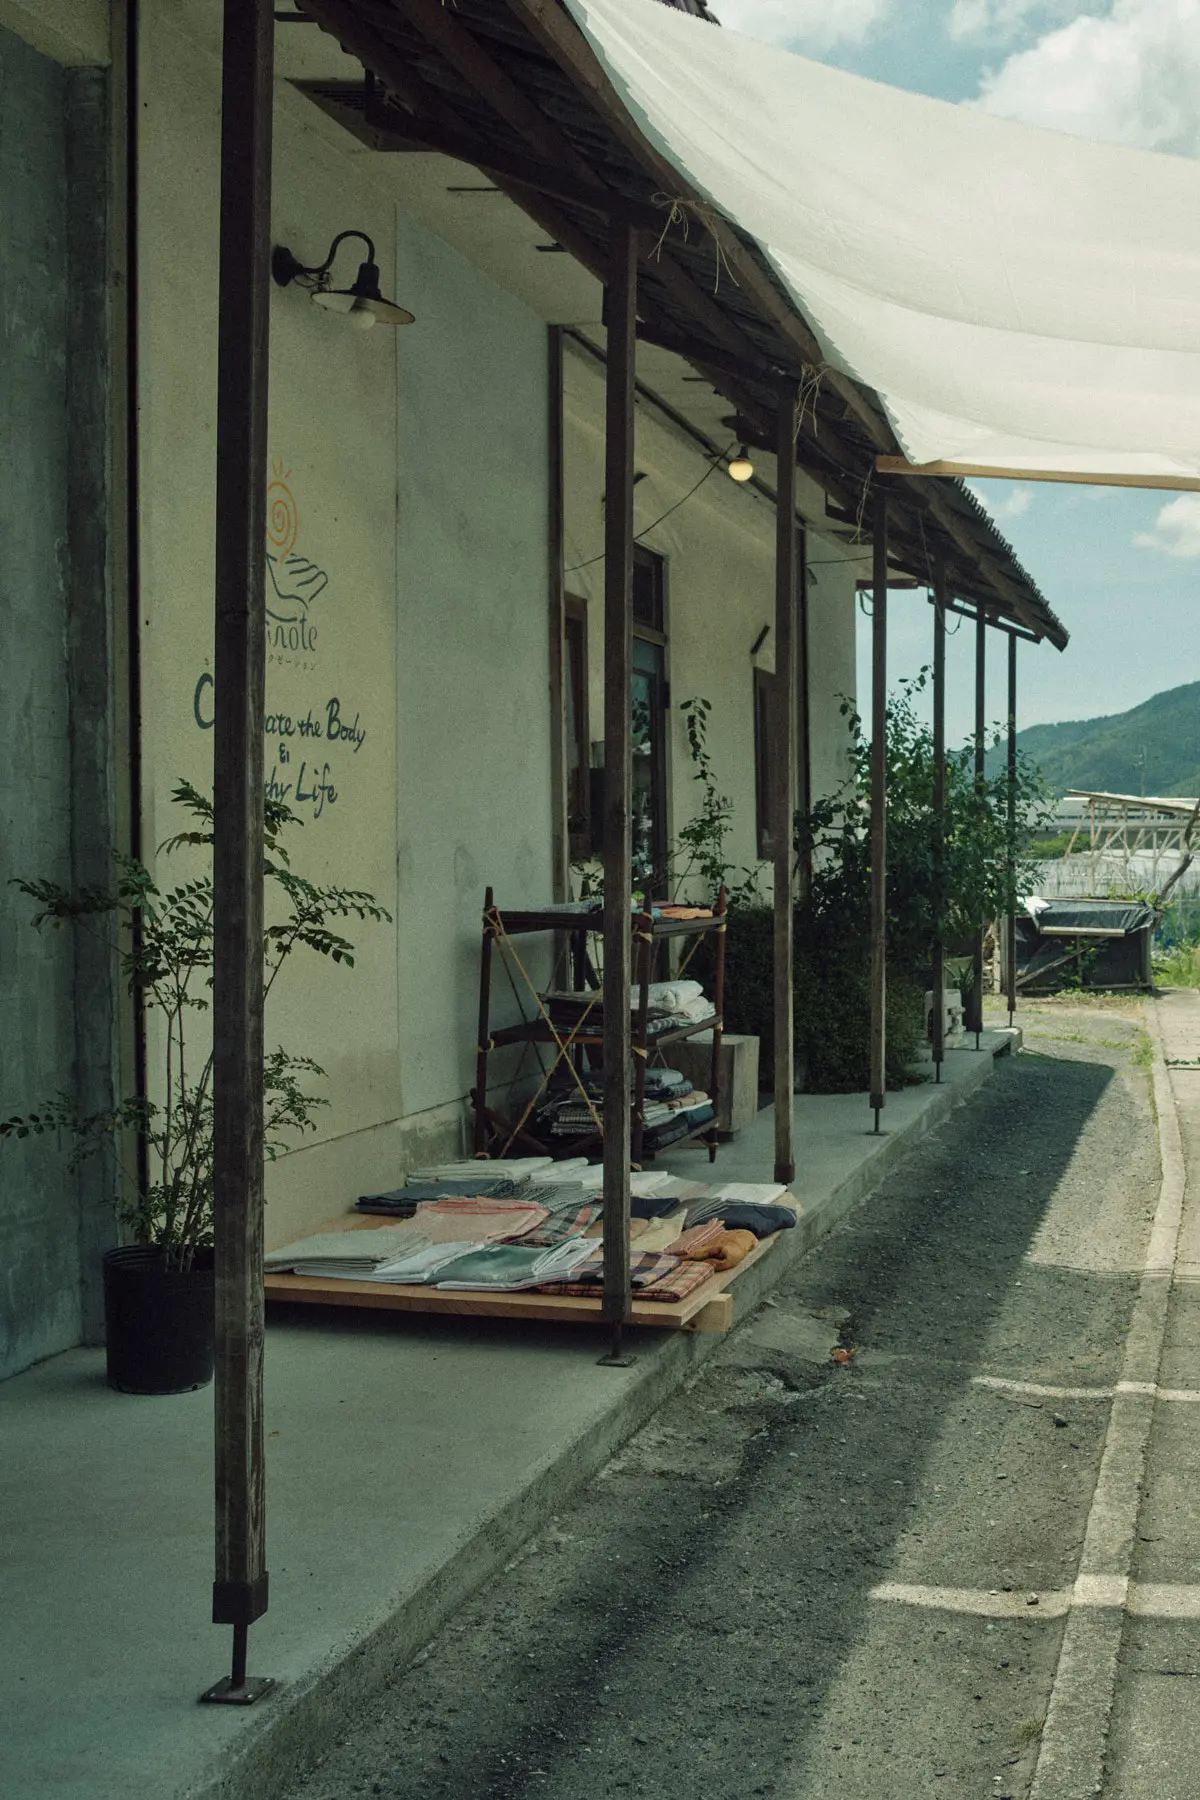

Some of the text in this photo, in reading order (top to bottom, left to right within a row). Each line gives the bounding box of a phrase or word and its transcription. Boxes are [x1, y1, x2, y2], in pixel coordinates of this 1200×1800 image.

[297, 709, 323, 738] the
[326, 697, 366, 753] Body
[295, 761, 338, 819] Life
